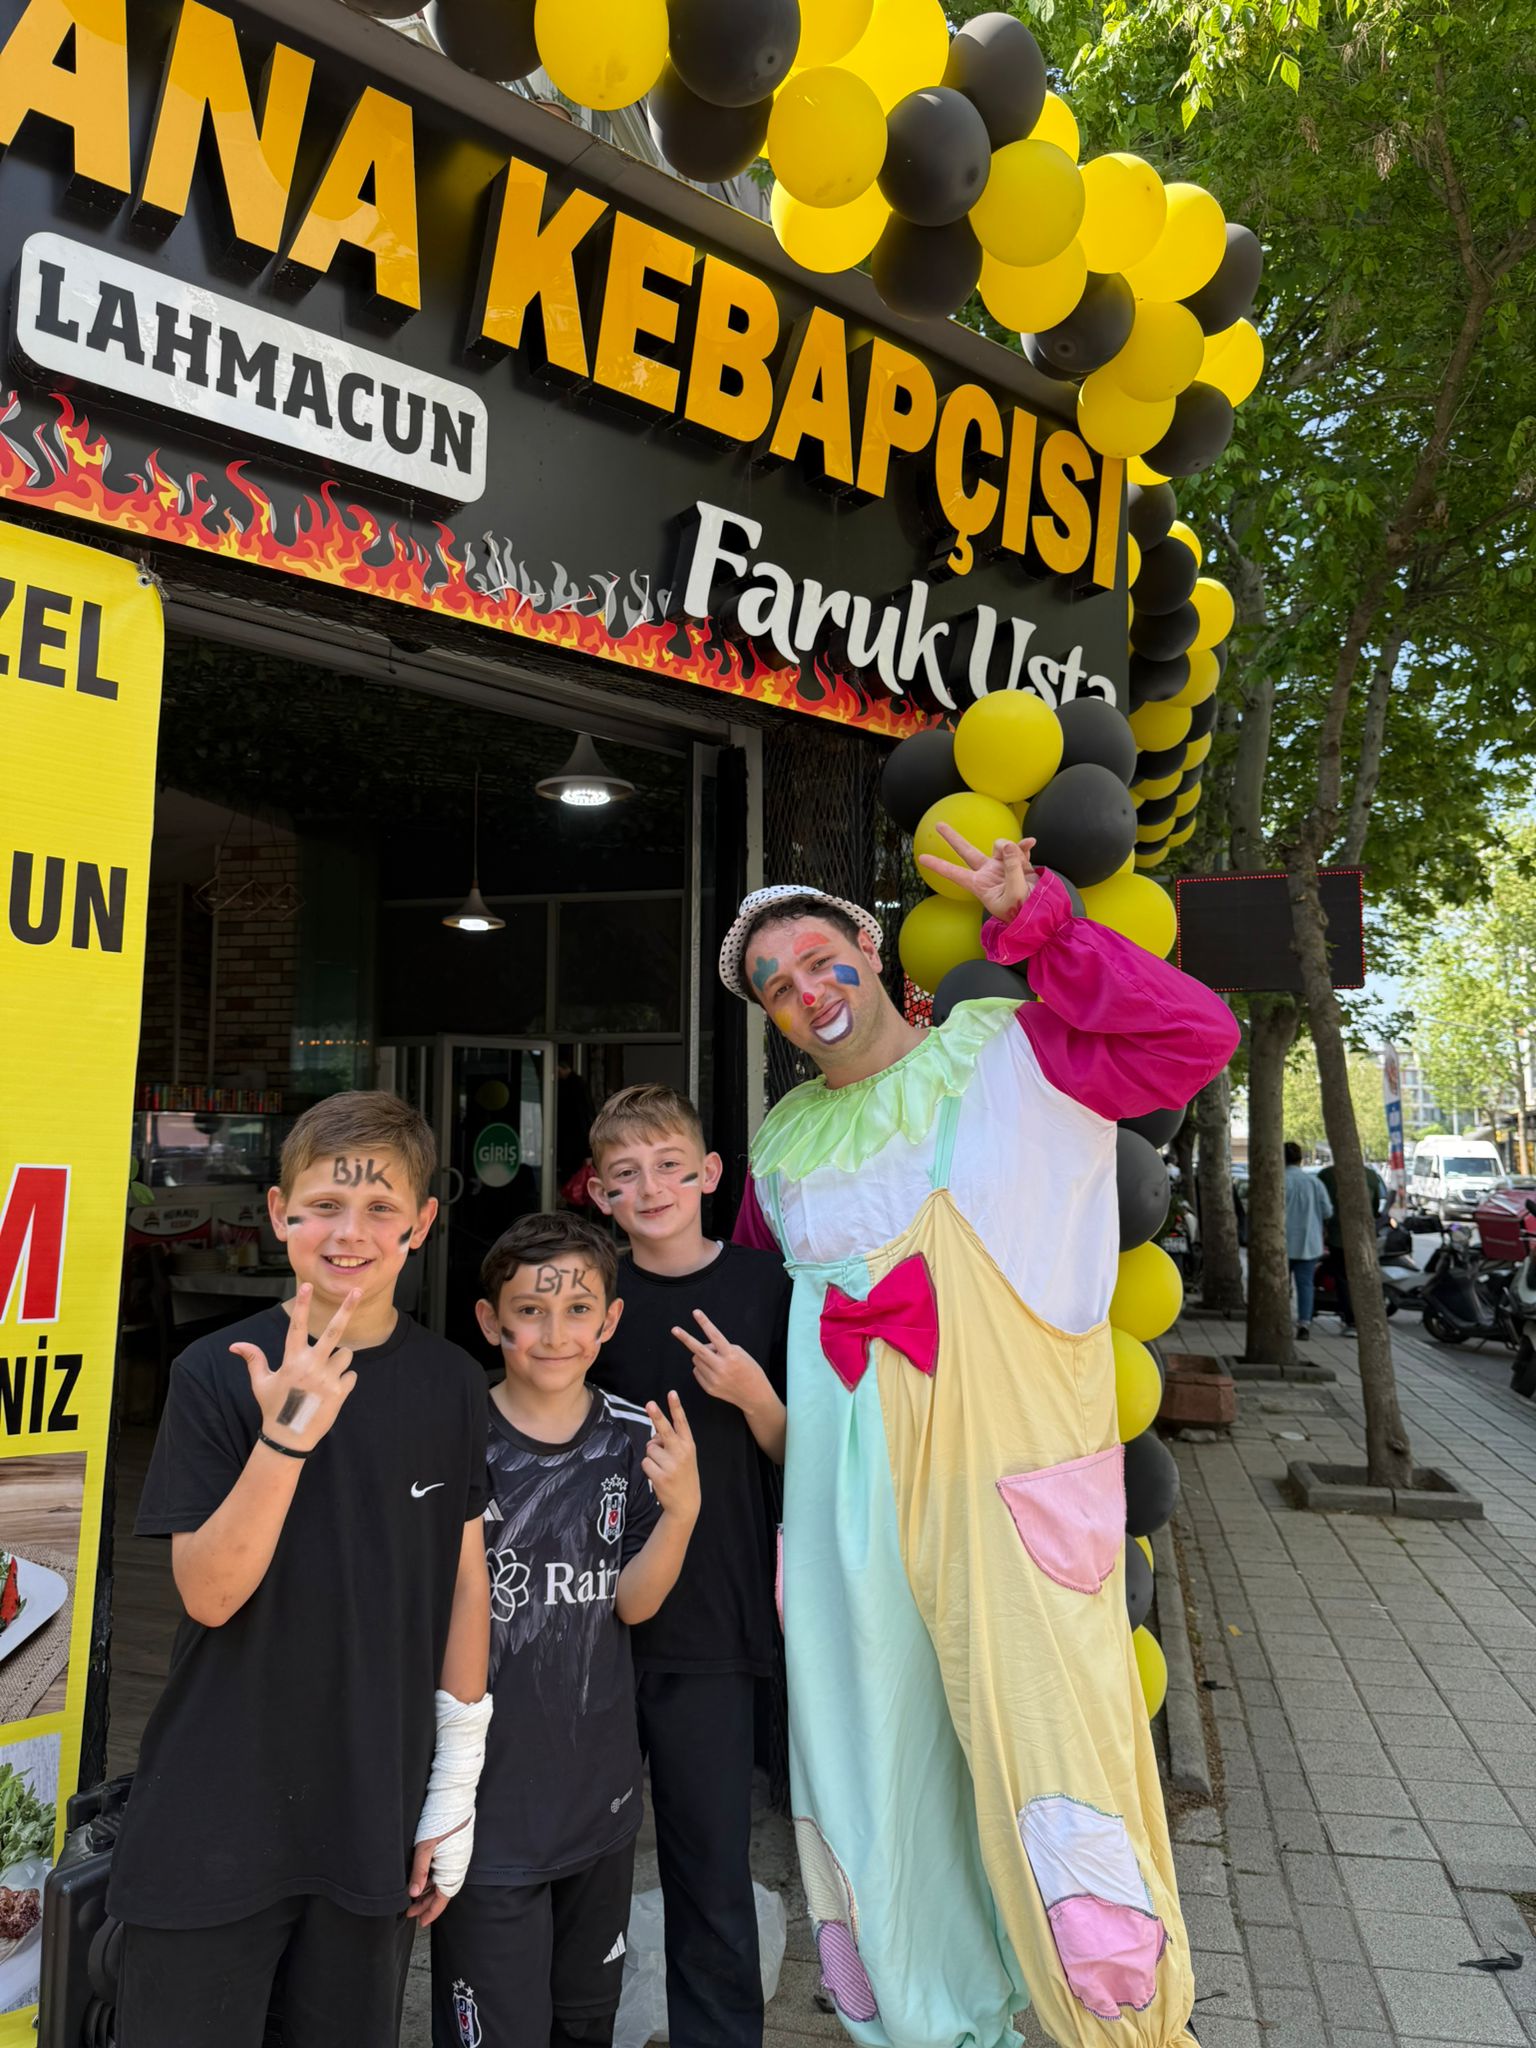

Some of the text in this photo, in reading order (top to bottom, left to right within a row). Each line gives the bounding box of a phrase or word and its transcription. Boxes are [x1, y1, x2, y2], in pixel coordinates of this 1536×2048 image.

[34, 259, 476, 475] LAHMACUN
[481, 156, 1126, 591] KEBAPÇISI
[683, 500, 958, 711] Faruk
[9, 850, 128, 954] UN
[478, 1142, 517, 1166] GİRİŞ
